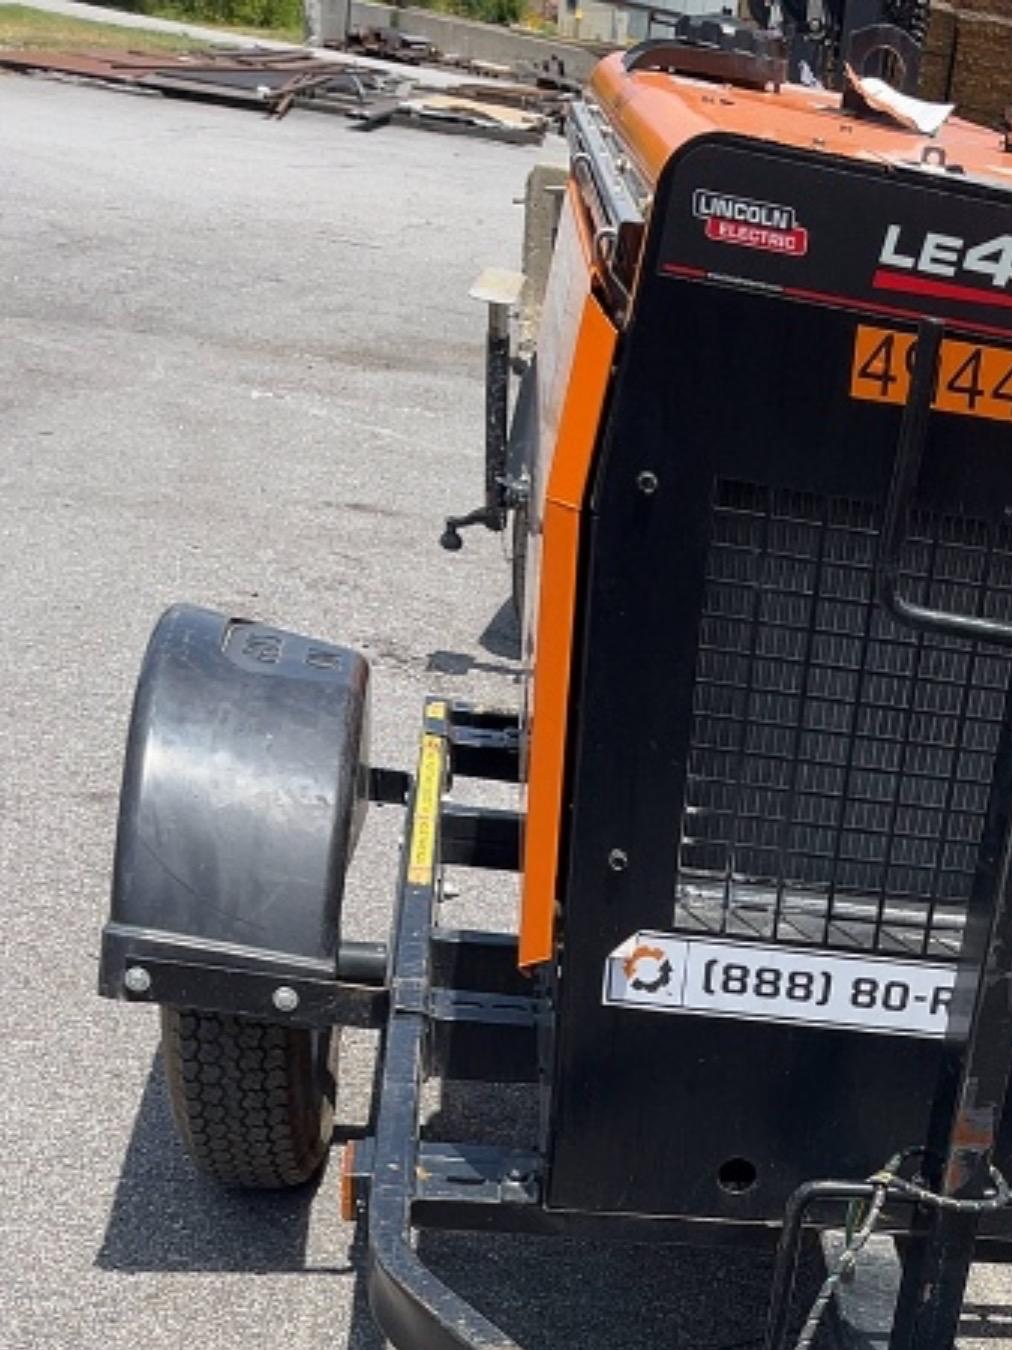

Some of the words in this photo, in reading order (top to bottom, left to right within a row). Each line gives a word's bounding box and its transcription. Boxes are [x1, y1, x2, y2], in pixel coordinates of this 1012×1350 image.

[698, 194, 789, 229] LINCOLN
[718, 222, 797, 250] ELECTRIC
[702, 959, 832, 1006] (888)
